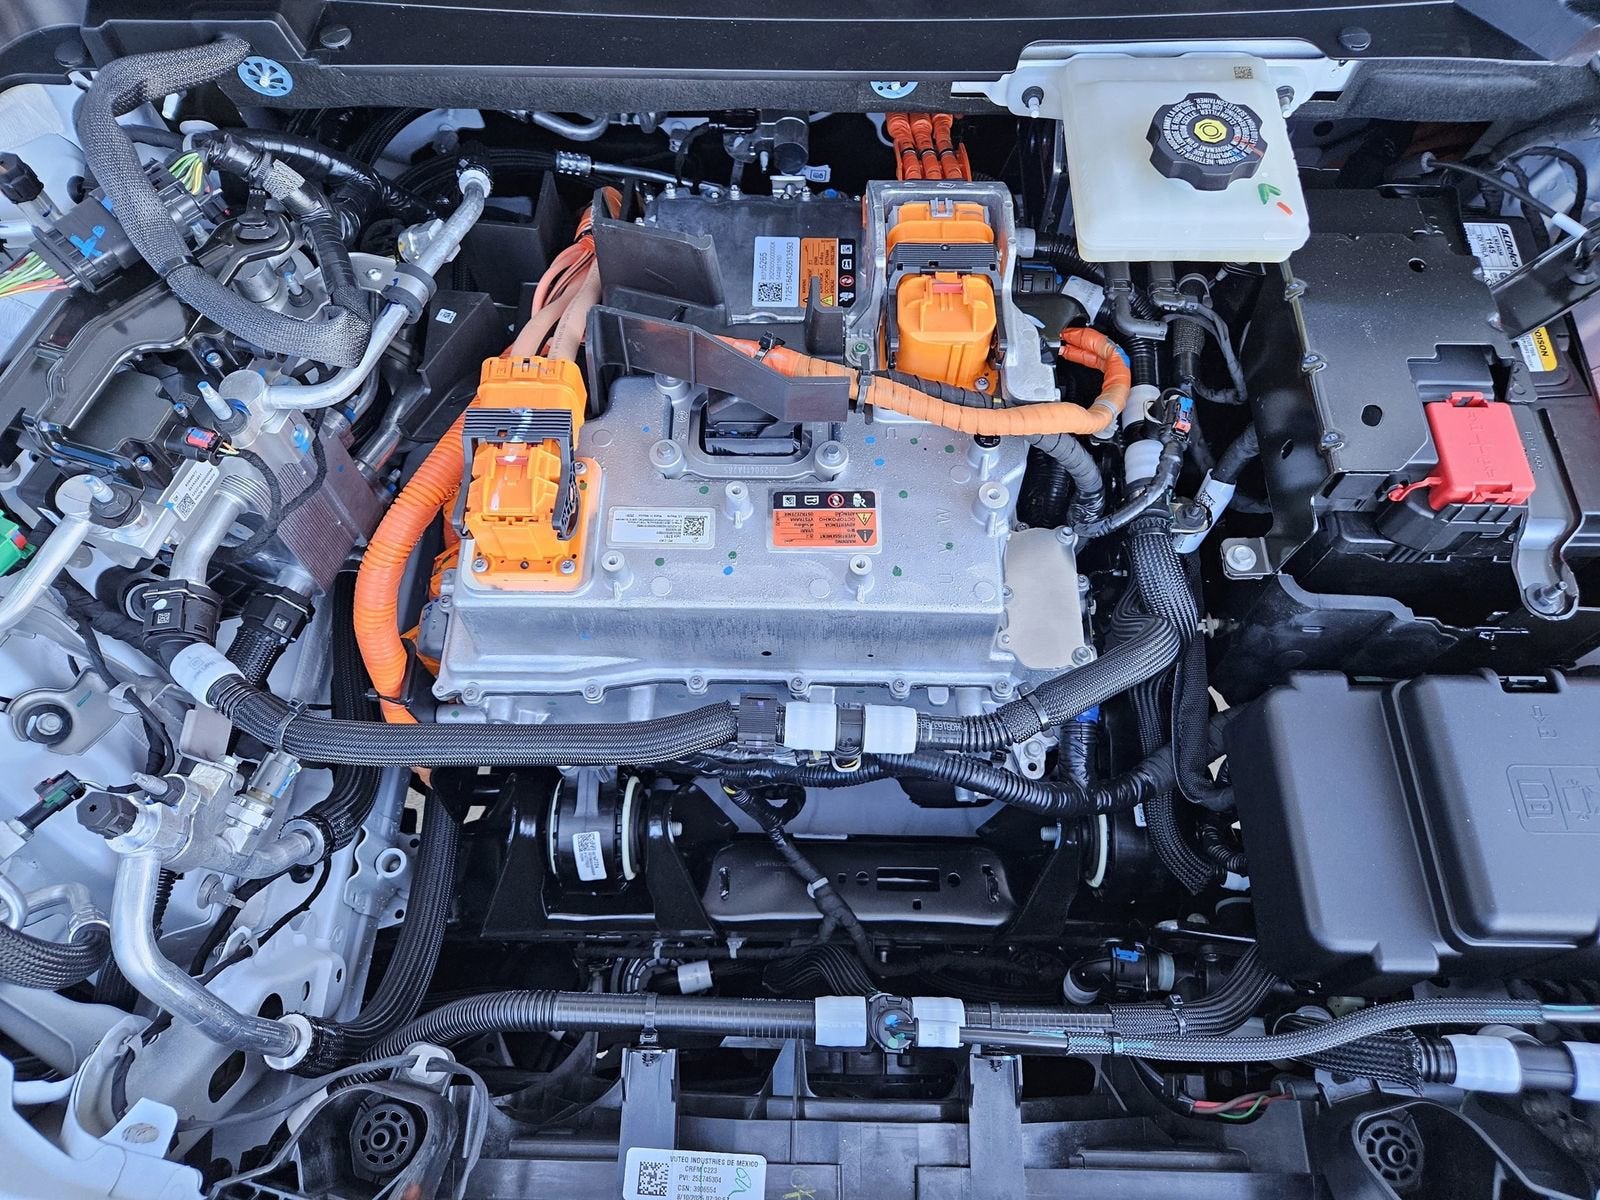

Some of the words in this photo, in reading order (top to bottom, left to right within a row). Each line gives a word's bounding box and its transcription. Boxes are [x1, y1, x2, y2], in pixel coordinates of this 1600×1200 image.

[1194, 98, 1229, 107] CONTAINER.
[1198, 144, 1233, 152] PROVENANT
[1184, 152, 1214, 165] NETTOYER
[1485, 238, 1495, 254] 1145
[1500, 227, 1519, 267] ACDelco
[1533, 328, 1549, 356] OISON
[690, 1157, 726, 1166] INDUSTRIES
[678, 1174, 690, 1182] PVI:
[677, 1184, 691, 1192] CSN:
